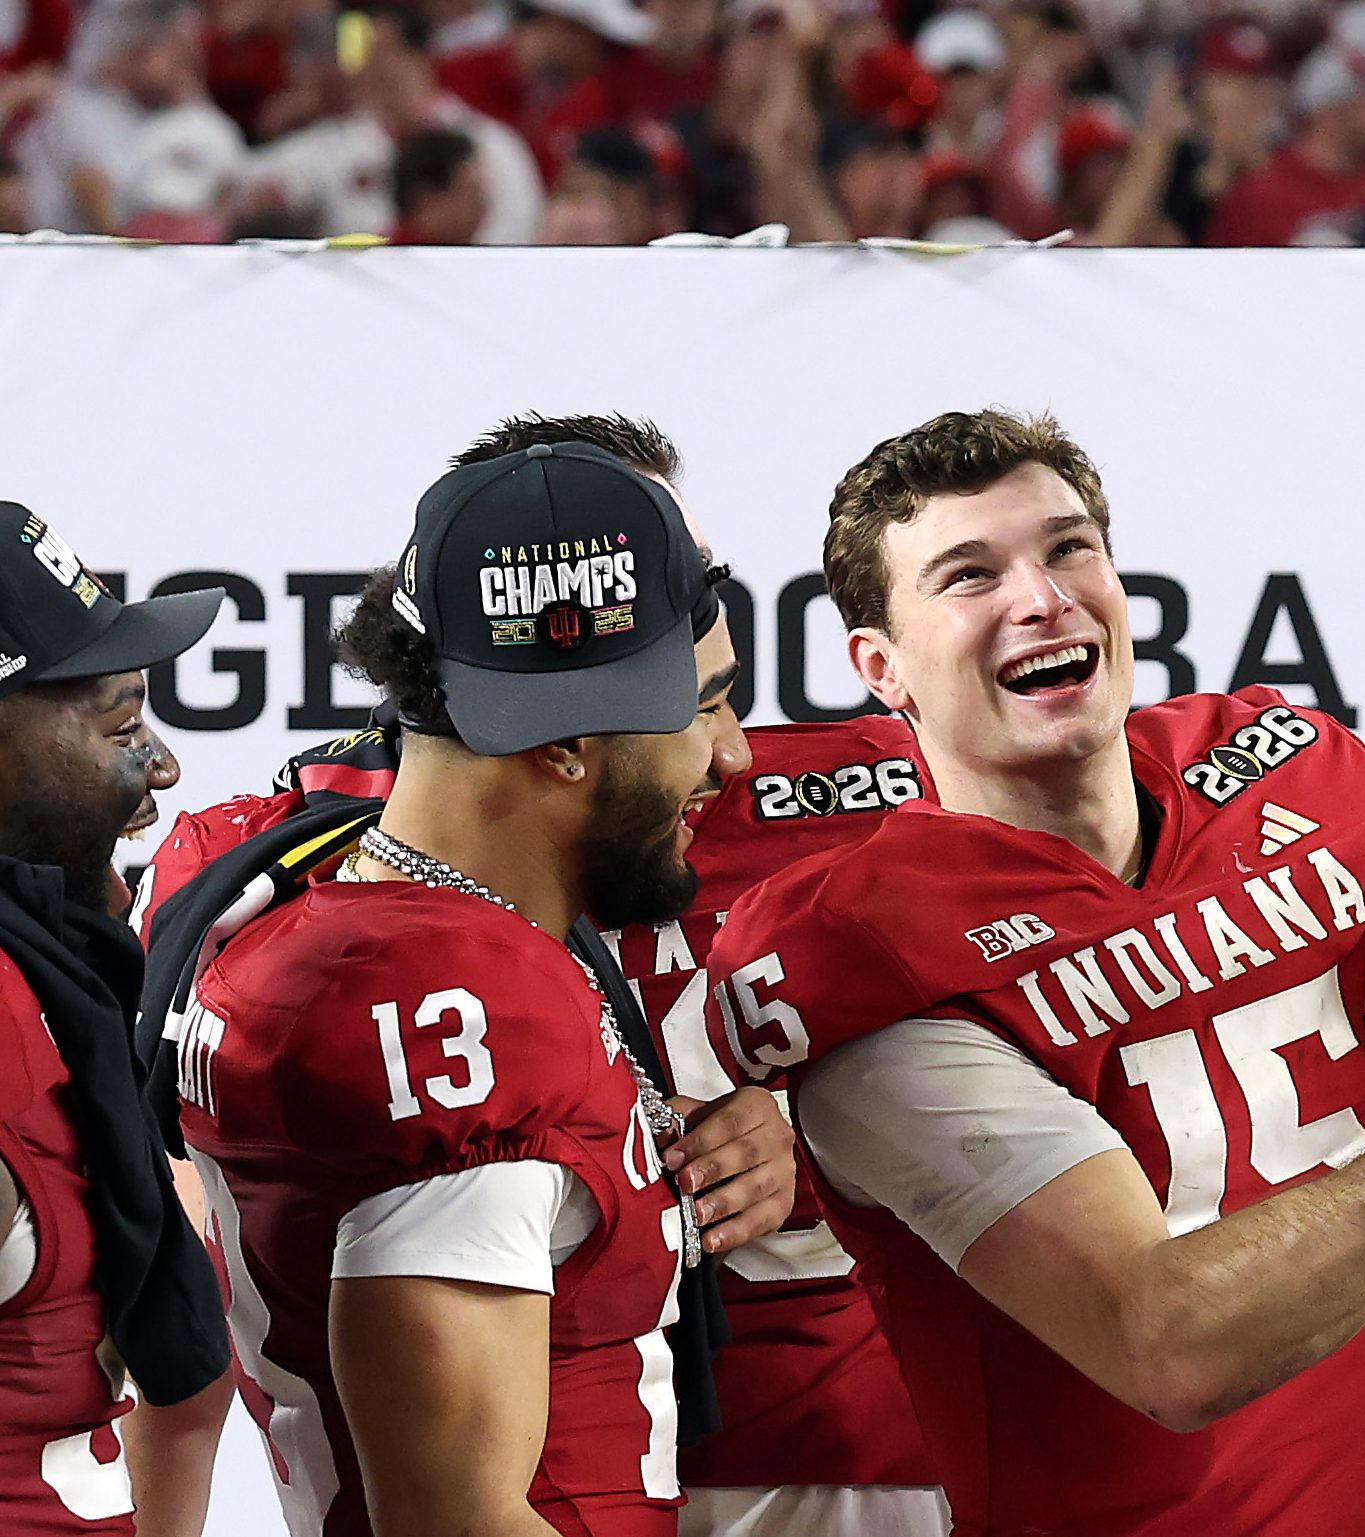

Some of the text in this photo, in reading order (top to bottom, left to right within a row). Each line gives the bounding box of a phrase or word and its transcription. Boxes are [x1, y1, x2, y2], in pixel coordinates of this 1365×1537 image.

[501, 534, 613, 564] NATIONAL
[479, 550, 638, 617] CHAMPS
[592, 604, 635, 636] 25
[713, 951, 811, 1081] 15
[371, 986, 496, 1122] 13
